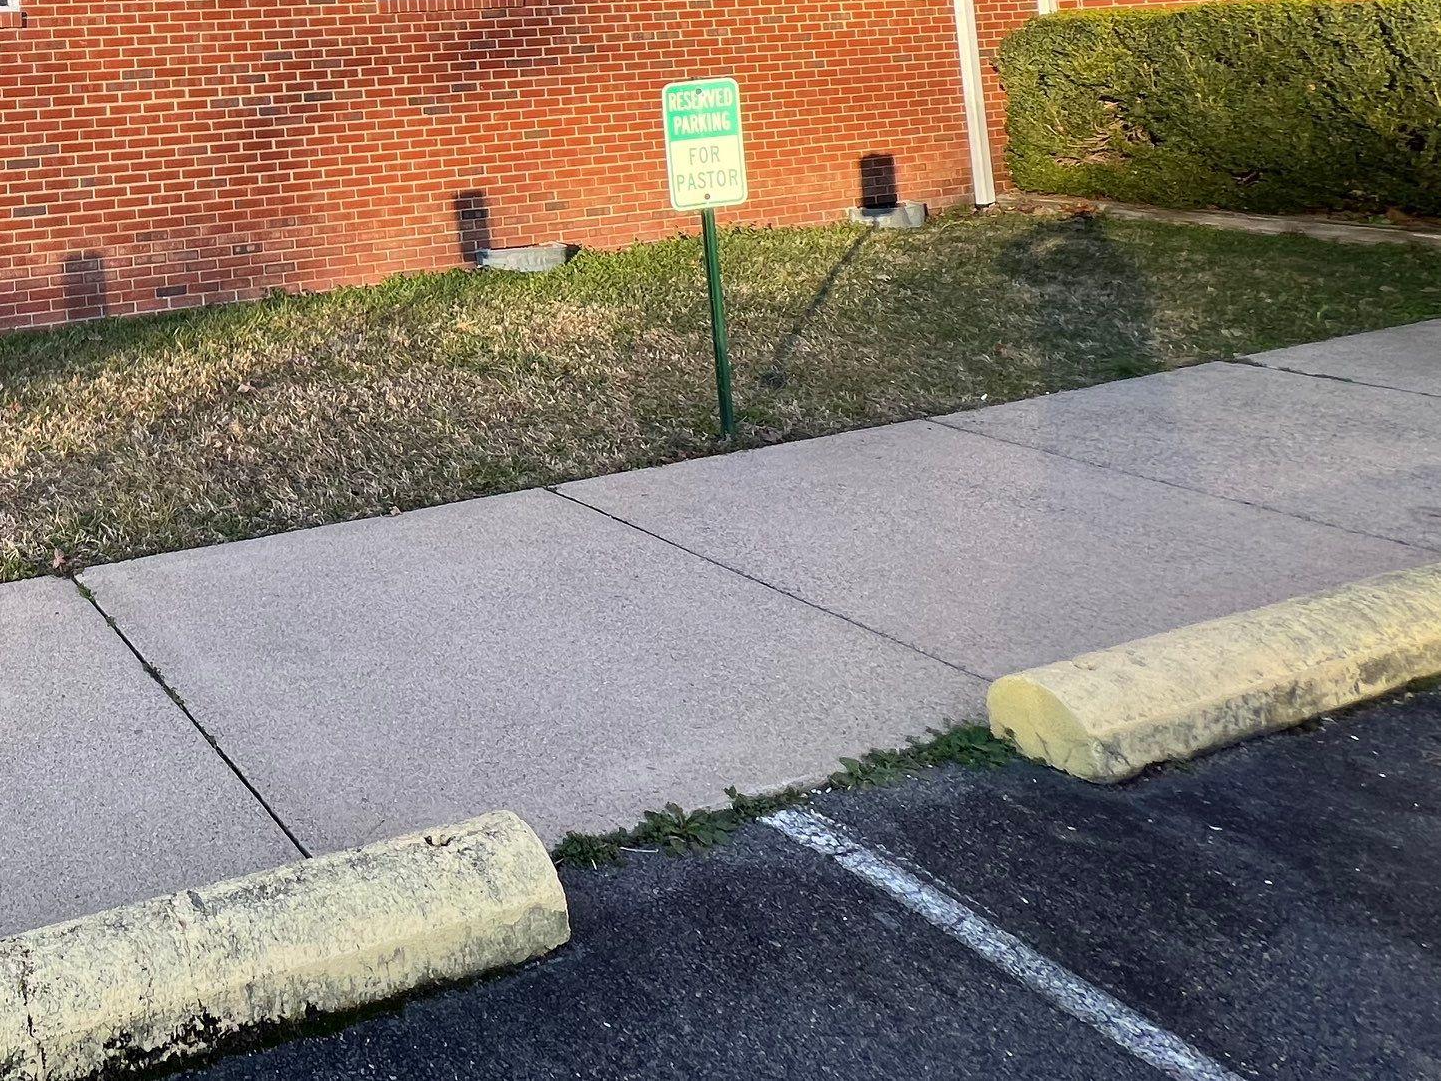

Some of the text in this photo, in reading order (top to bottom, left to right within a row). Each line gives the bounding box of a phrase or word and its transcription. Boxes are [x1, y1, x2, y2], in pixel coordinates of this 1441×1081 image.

[667, 87, 733, 112] RESERVED
[673, 112, 731, 135] PARKING
[689, 145, 720, 165] FOR
[676, 169, 738, 192] PASTOR
